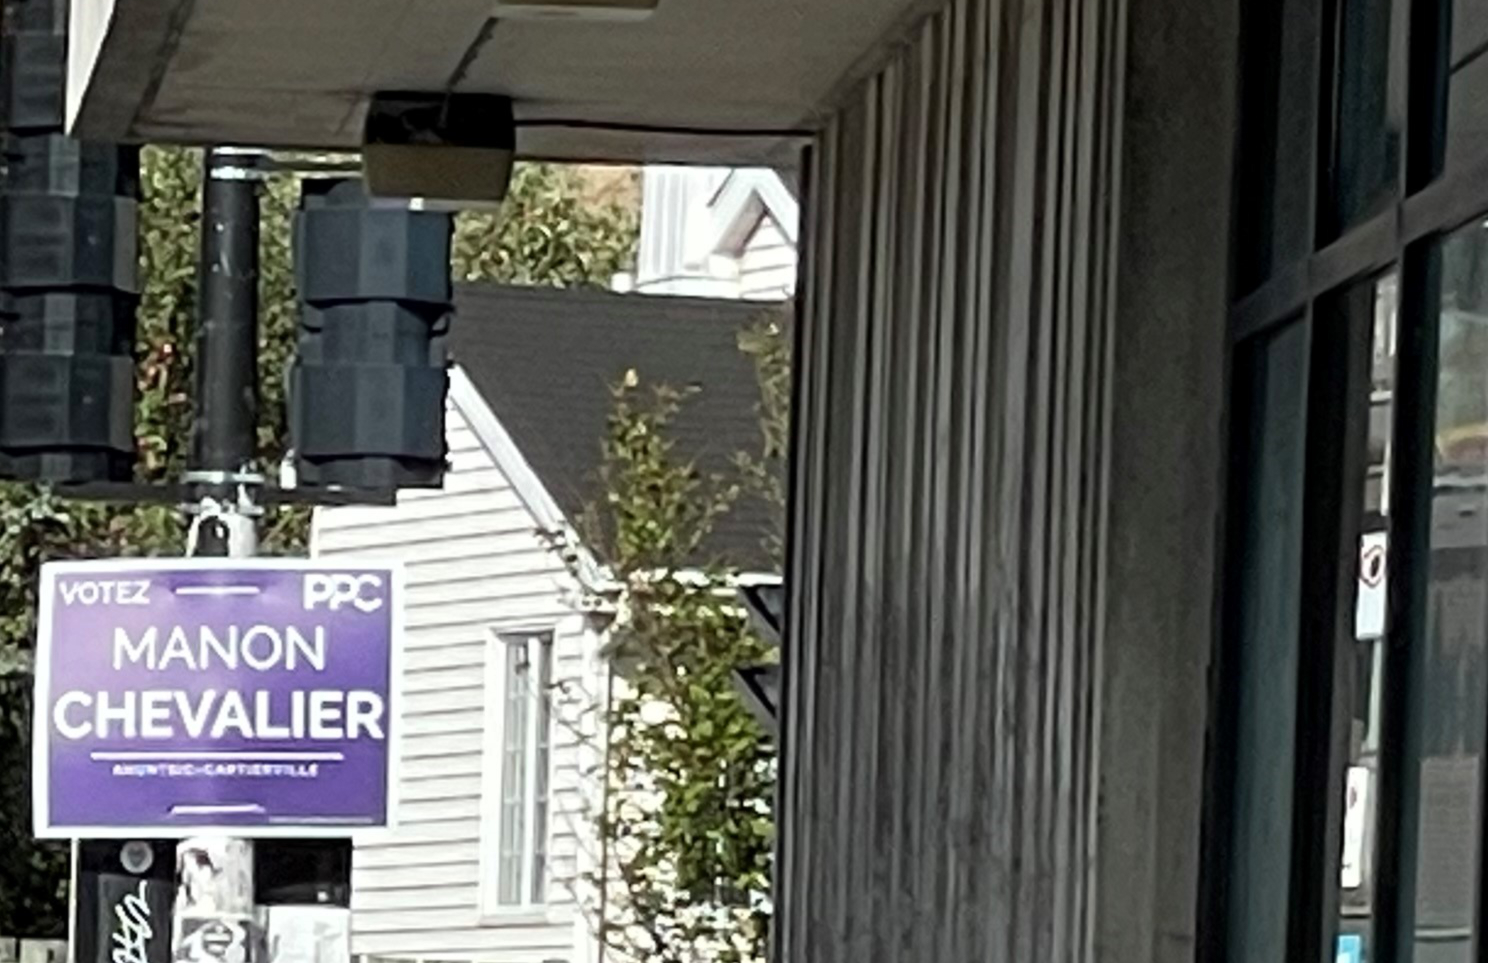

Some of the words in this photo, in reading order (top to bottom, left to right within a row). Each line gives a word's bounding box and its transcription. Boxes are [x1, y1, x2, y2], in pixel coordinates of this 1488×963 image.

[59, 580, 151, 606] VOTEZ
[303, 573, 384, 612] PPC
[112, 625, 325, 671] MANON
[53, 689, 385, 739] CHEVALIER
